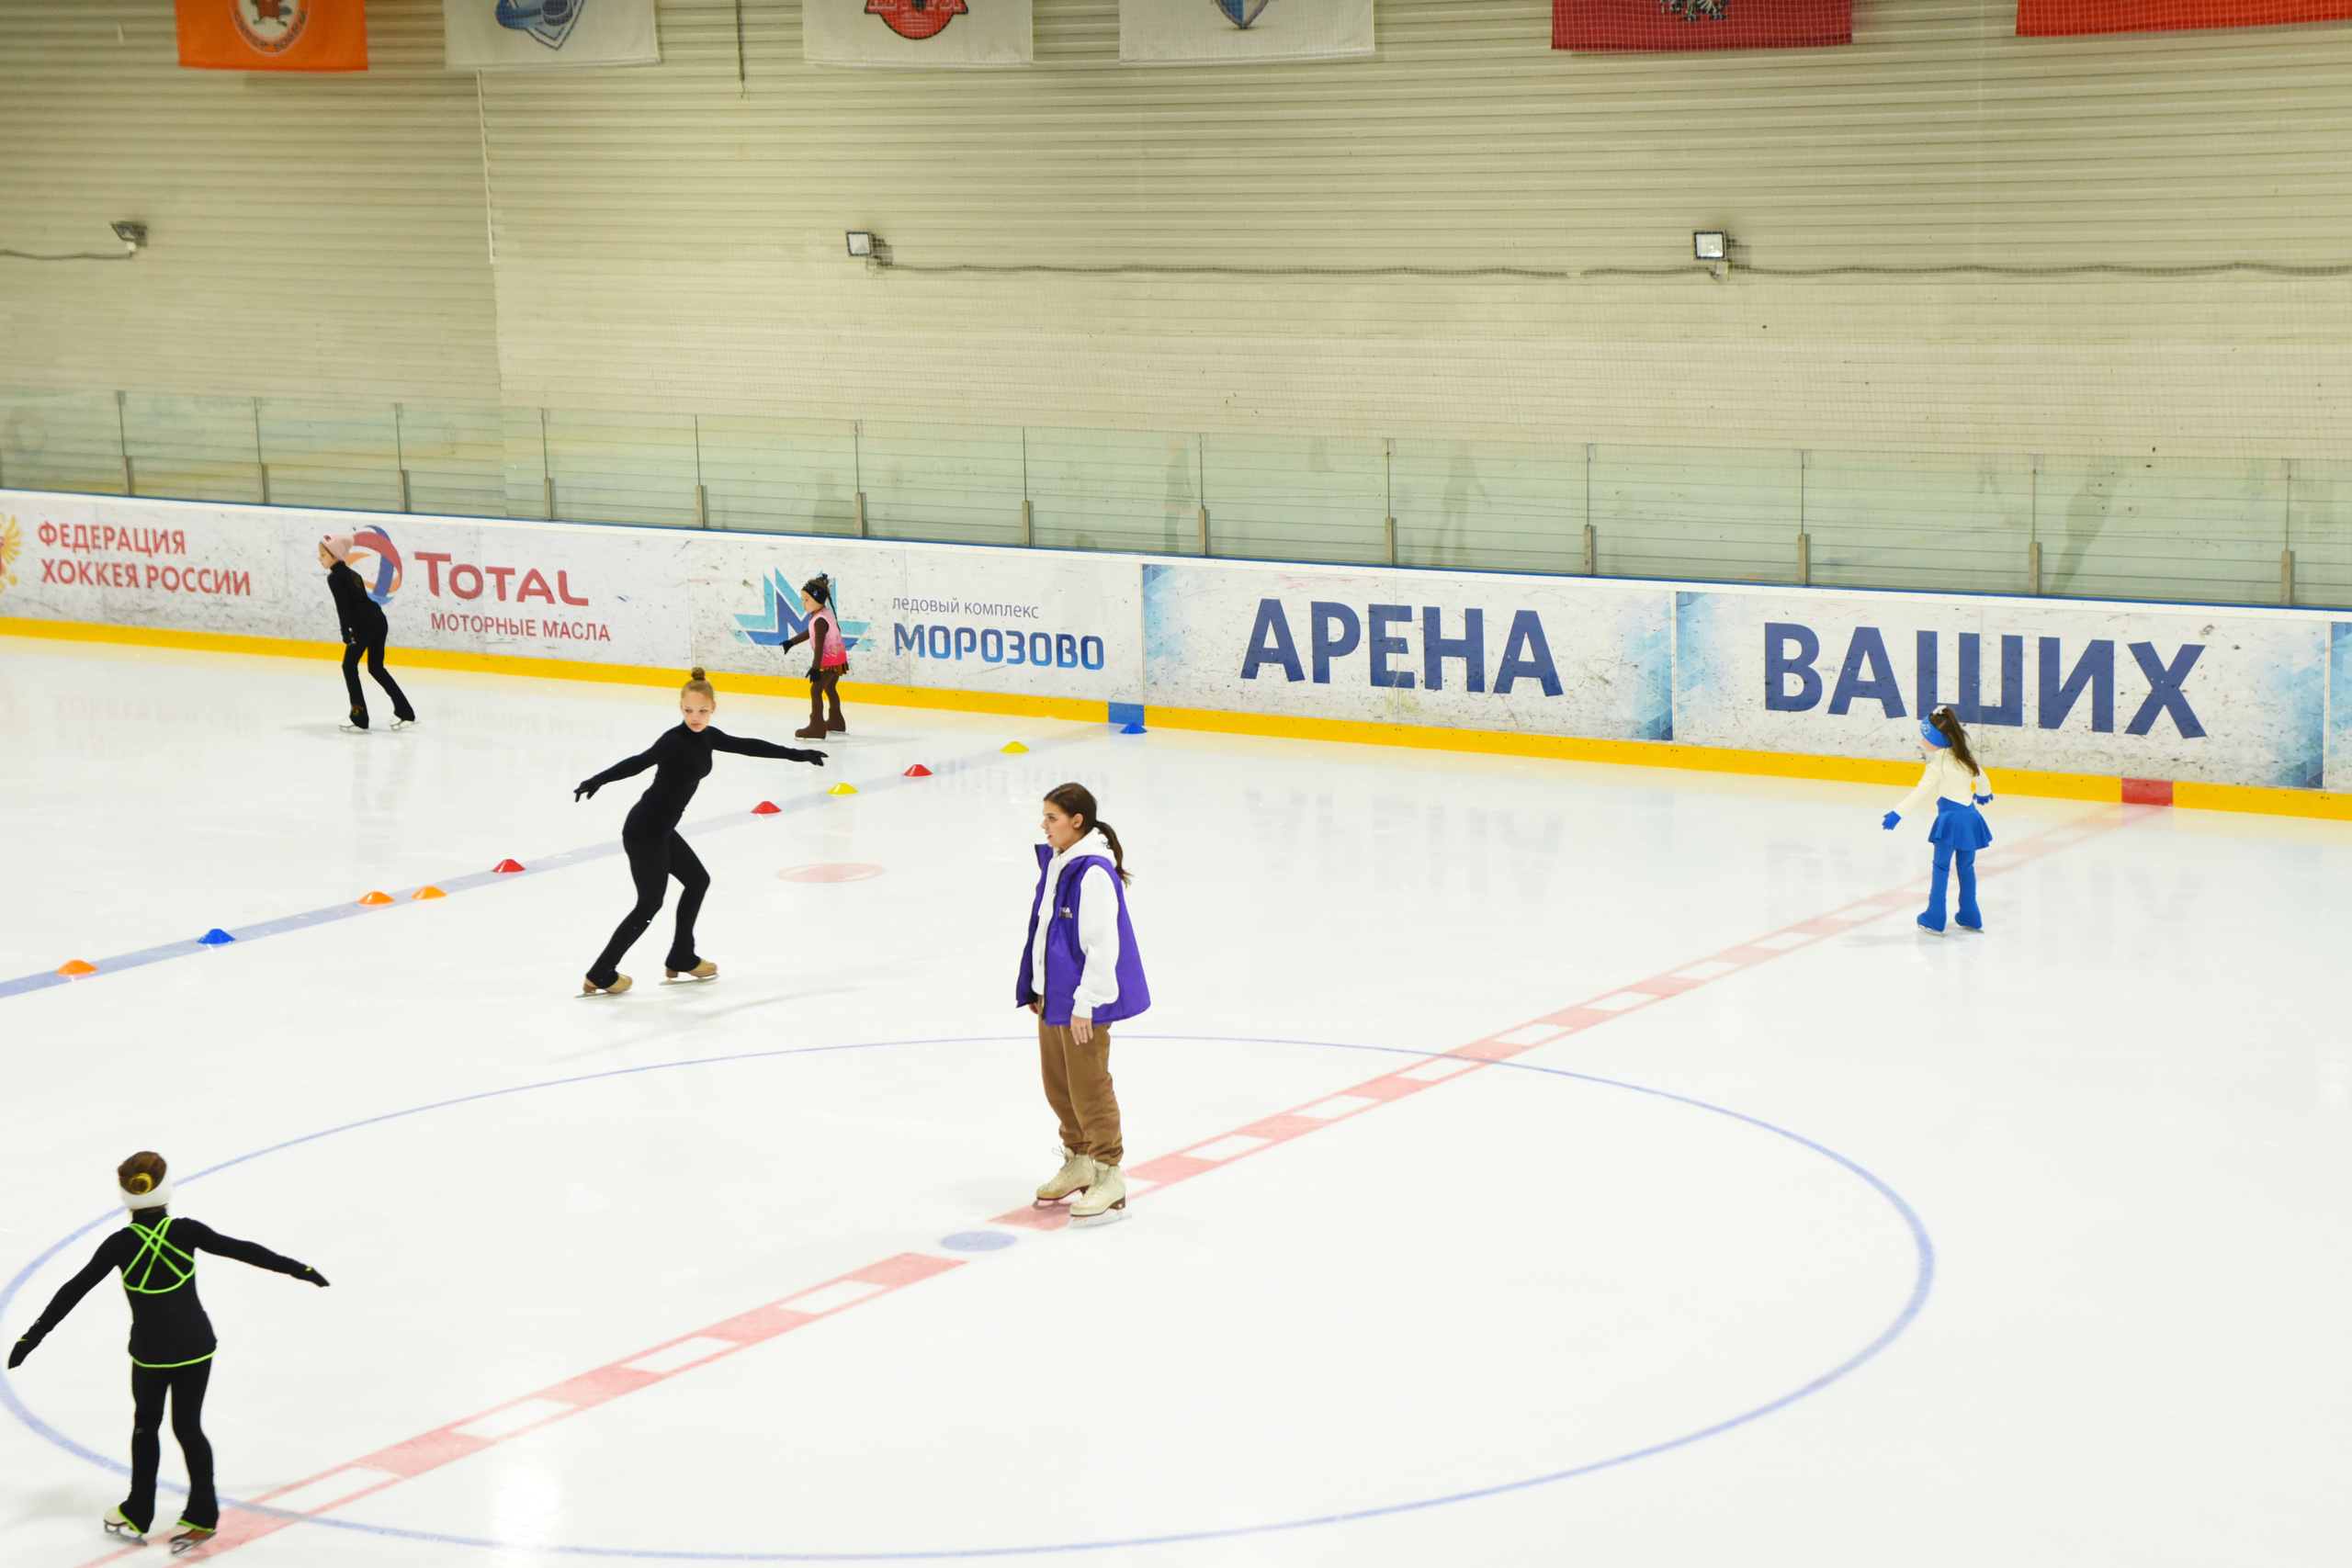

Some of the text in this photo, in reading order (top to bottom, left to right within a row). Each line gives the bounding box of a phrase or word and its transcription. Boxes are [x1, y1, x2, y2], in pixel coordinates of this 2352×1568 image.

[38, 520, 186, 557] ФЕДЕРАЦИЯ
[40, 558, 251, 596] ХОККЕЯ РОССИИ
[414, 551, 589, 606] TOTAL
[431, 612, 611, 641] МОТОРНЫЕ МАСЛА
[892, 597, 1039, 619] ледовый комплекс
[894, 622, 1105, 671] МОРОЗОВО
[1239, 597, 1564, 697] АРЕНА
[1764, 622, 2208, 739] ВАШИХ
